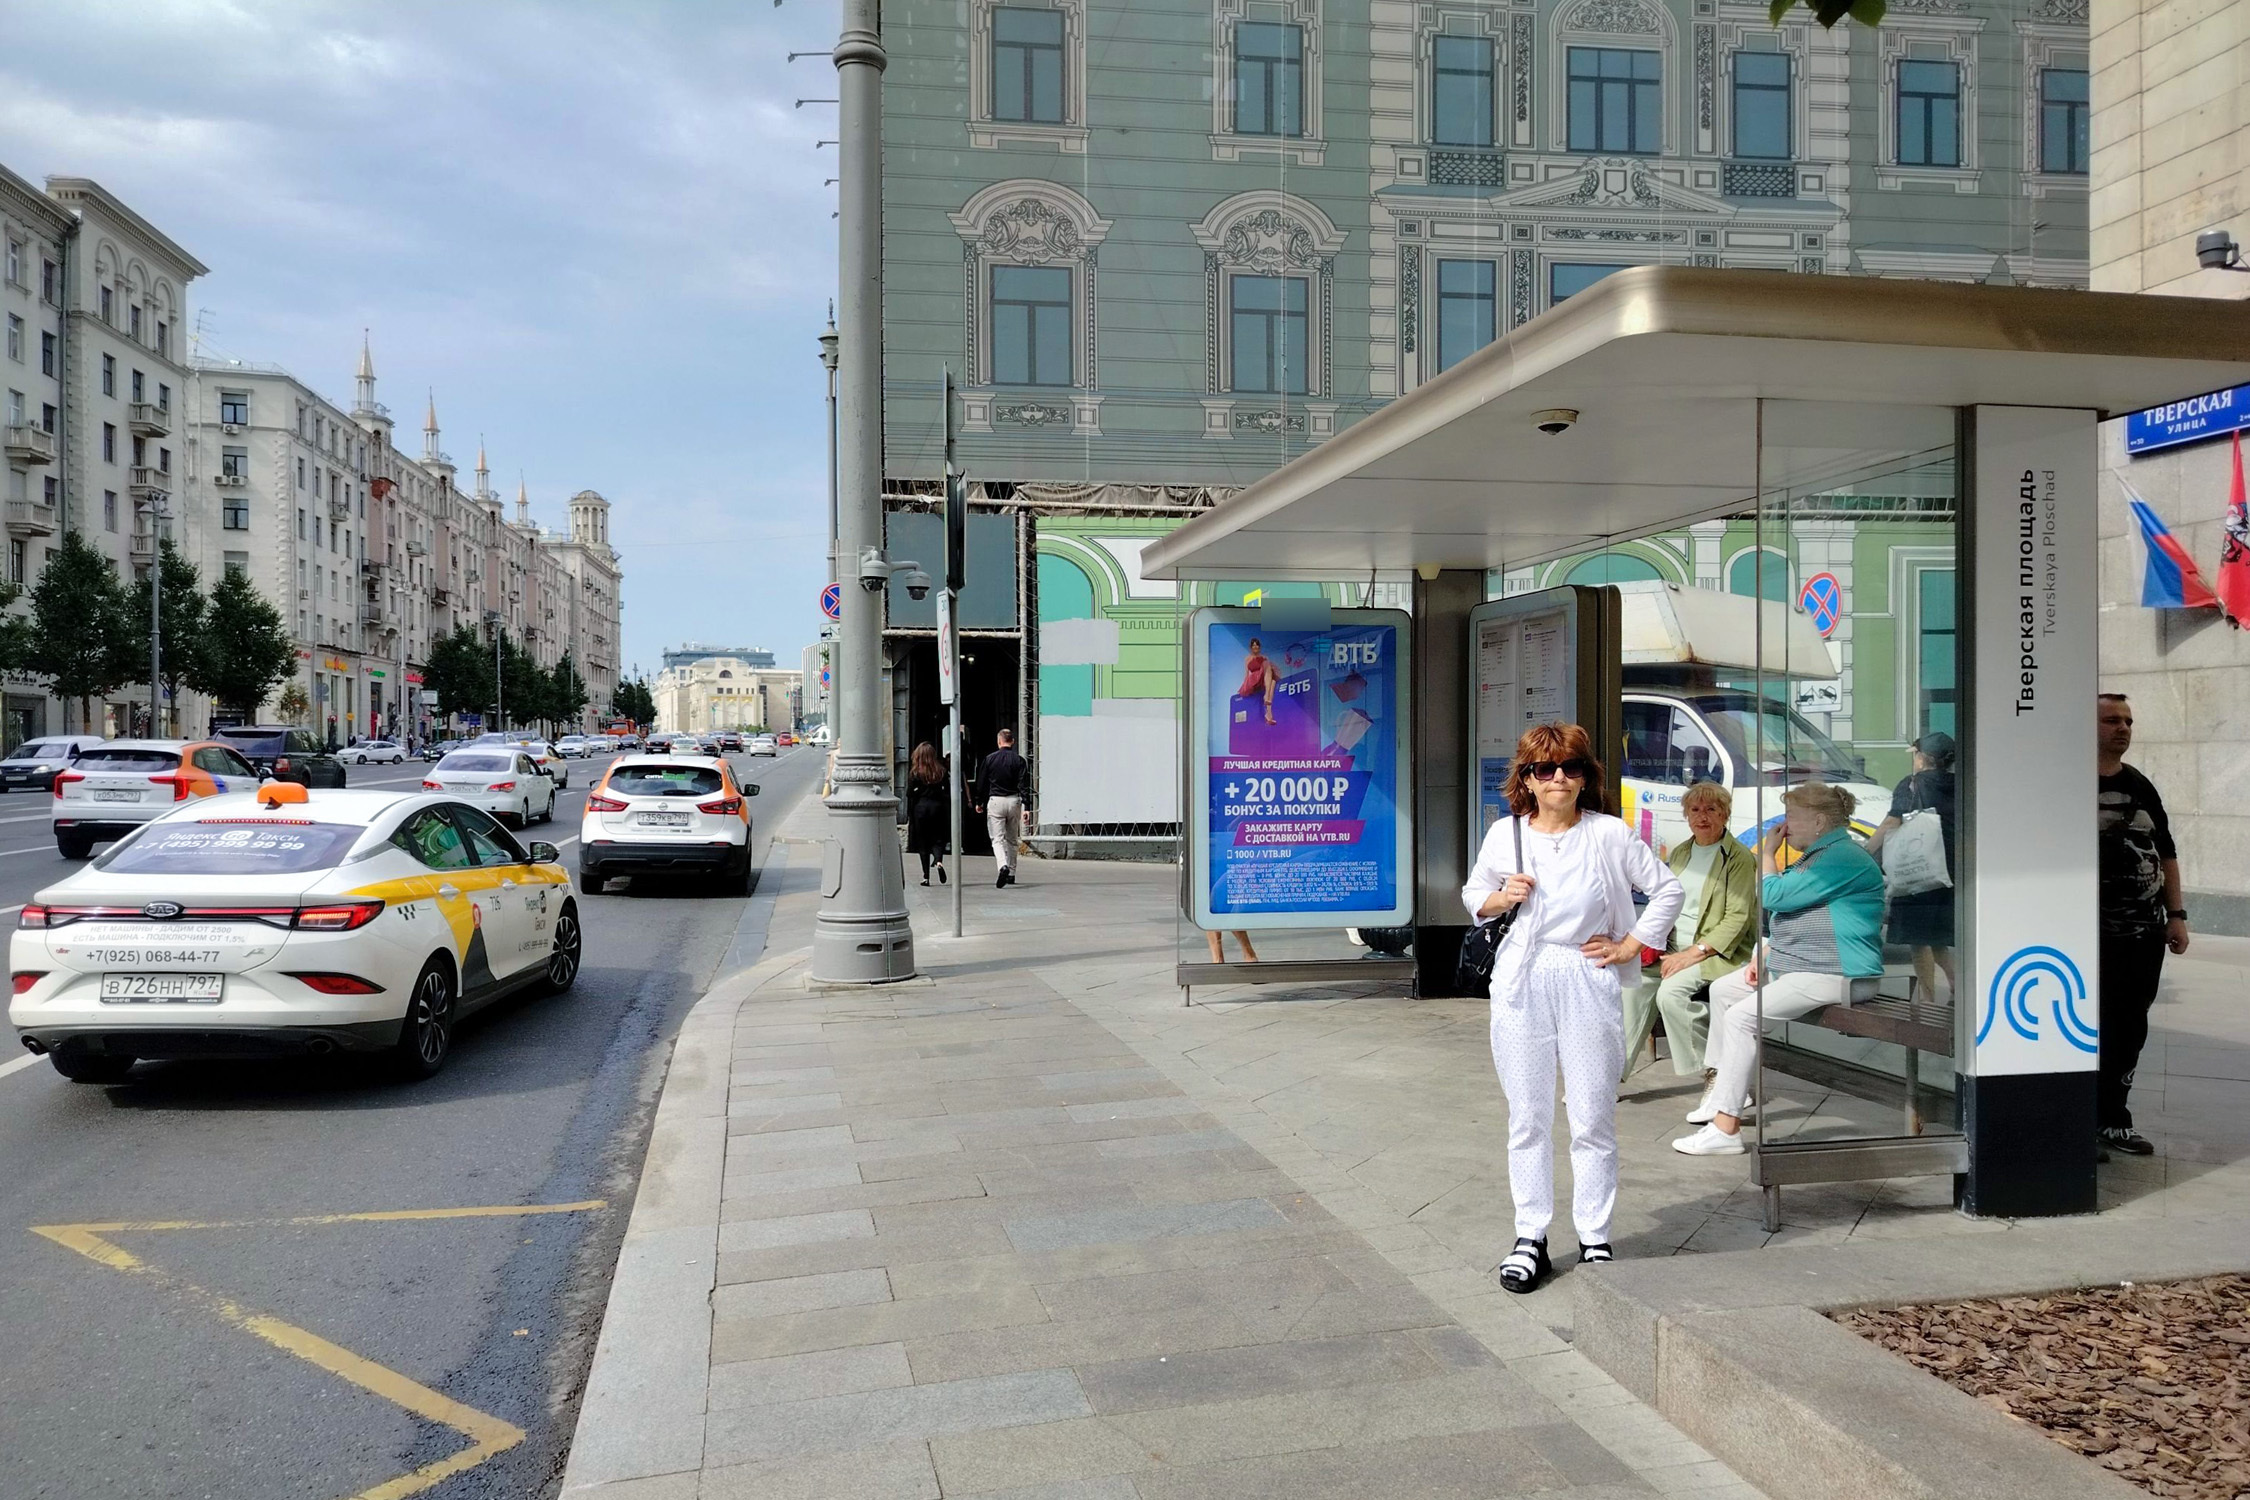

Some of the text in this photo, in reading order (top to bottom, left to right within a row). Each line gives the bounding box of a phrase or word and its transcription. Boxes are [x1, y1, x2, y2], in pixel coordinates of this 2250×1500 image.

[2143, 389, 2232, 426] ТВЕРСКАЯ
[2167, 417, 2207, 434] УЛИЦА
[2042, 470, 2059, 638] Tverskaya Ploschad
[2016, 469, 2038, 717] Тверская площадь
[1334, 643, 1377, 664] ВТБ
[1288, 679, 1311, 695] ВТБ
[1223, 760, 1341, 770] ЛУЧШАЯ КРЕДИТНАЯ КАРТА
[1245, 777, 1276, 802] 20
[1280, 777, 1328, 801] 000
[1224, 804, 1340, 816] БОНУС ЗА ПОКУПКИ
[1245, 823, 1323, 832] ЗАКАЖИТЕ КАРТУ
[164, 832, 220, 841] Яндекс
[256, 832, 299, 842] Такси
[1245, 832, 1350, 844] С ДОСТАВКОЙ НА VTB.RU
[159, 840, 211, 850] (495)
[212, 841, 250, 849] 999
[251, 841, 277, 849] 99
[278, 842, 305, 850] 99
[1234, 850, 1254, 858] 1000
[1262, 849, 1291, 858] VTB.RU
[160, 925, 194, 933] ДАДИМ
[146, 934, 207, 942] ПОДКЛЮЧИМ
[87, 950, 220, 965] +7(925) 068-44-77
[108, 976, 217, 995] В726НН 797
